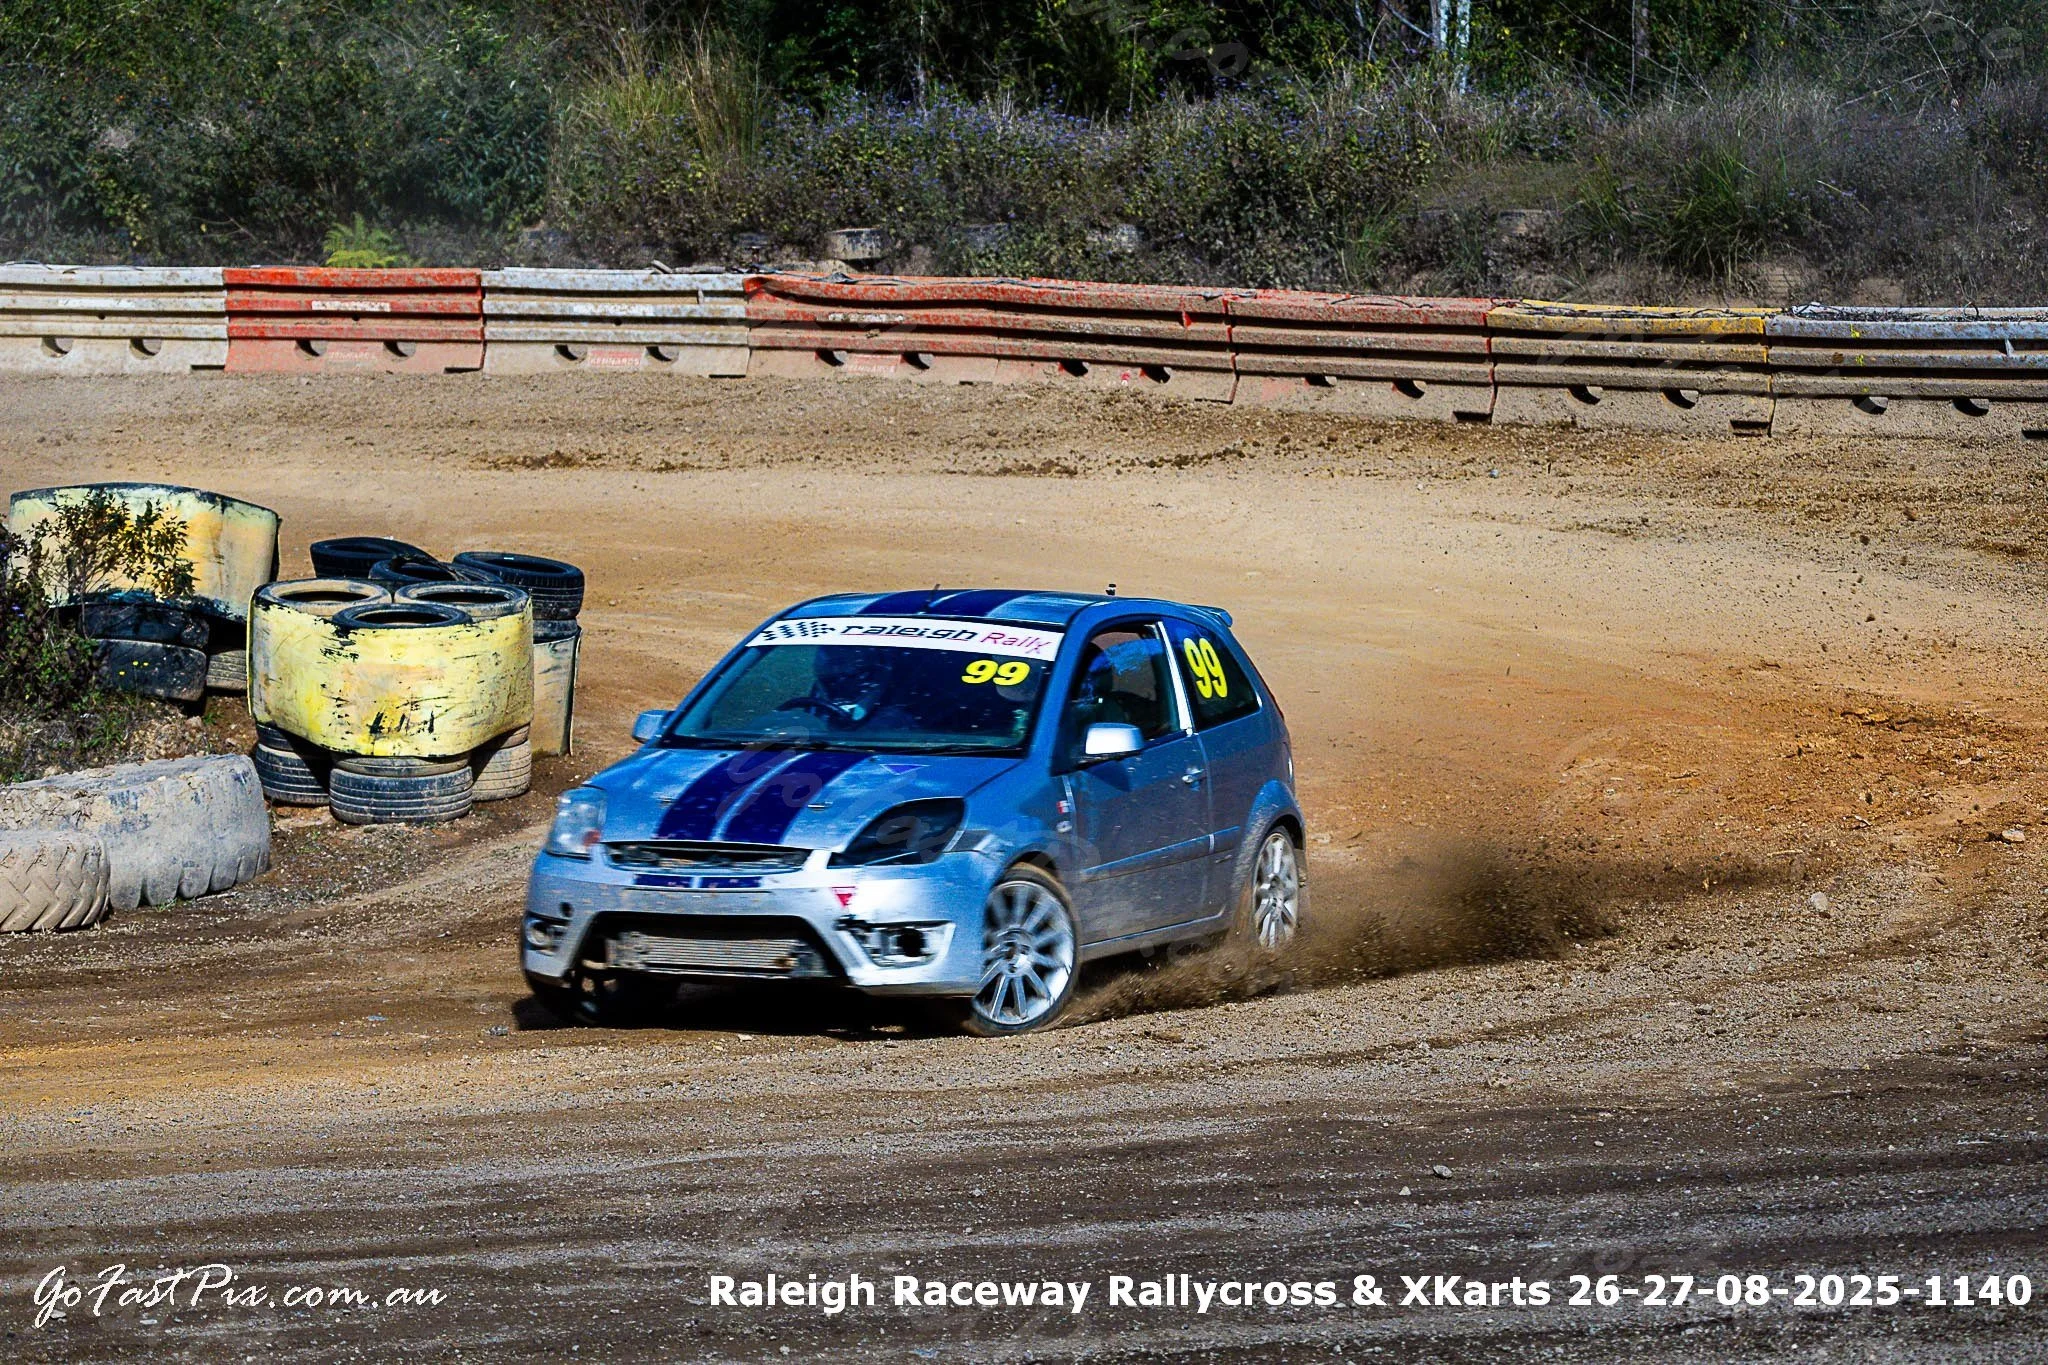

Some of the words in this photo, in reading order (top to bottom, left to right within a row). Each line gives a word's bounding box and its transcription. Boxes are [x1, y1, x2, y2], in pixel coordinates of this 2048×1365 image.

[841, 624, 978, 642] raleigh
[980, 631, 1052, 655] Rally
[961, 659, 1031, 686] 99
[1183, 637, 1228, 699] 99
